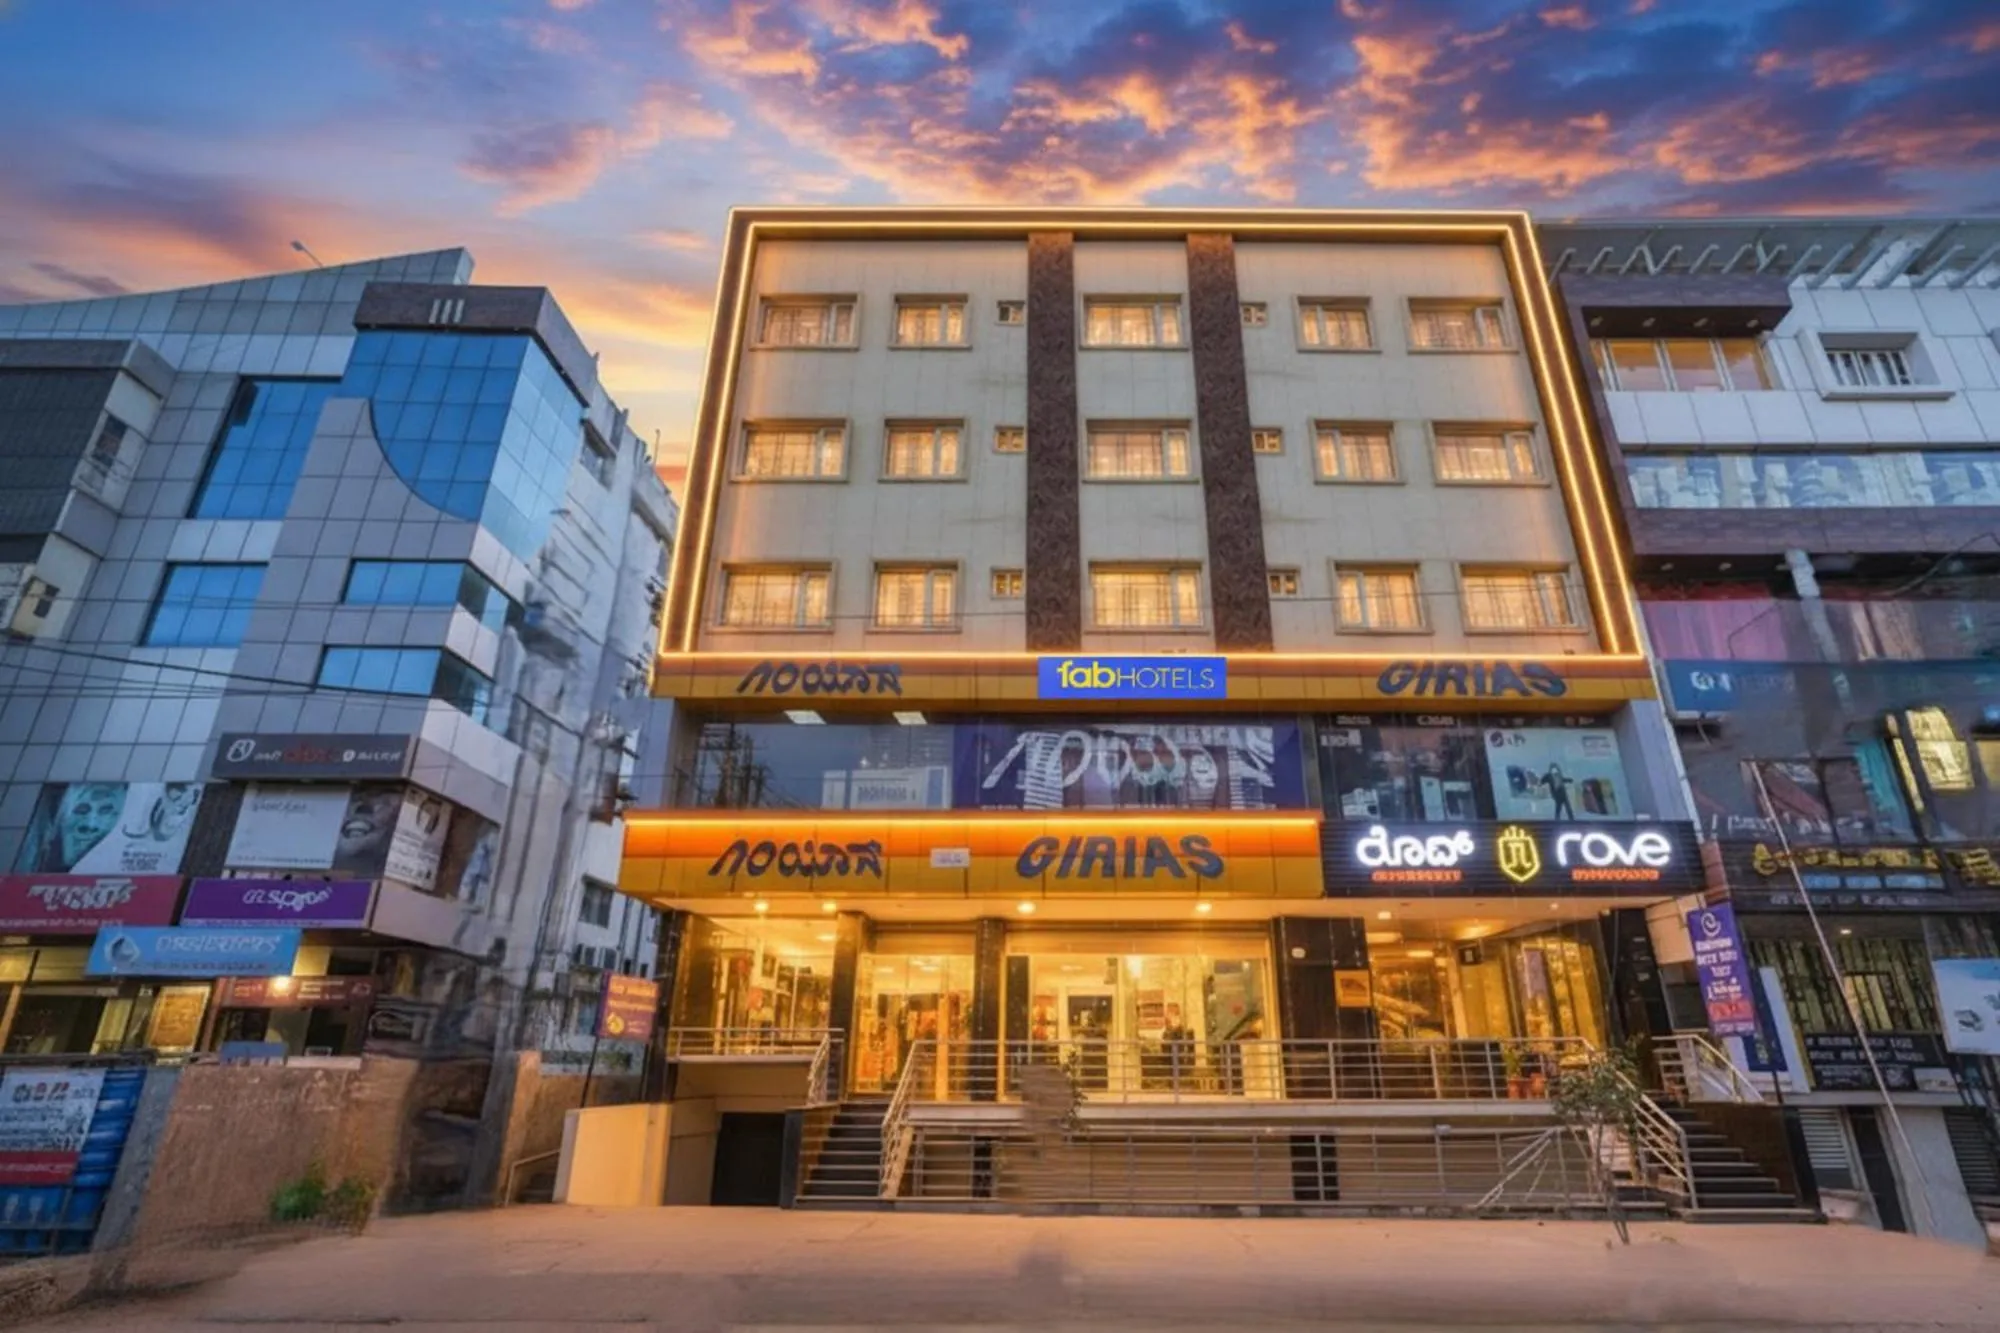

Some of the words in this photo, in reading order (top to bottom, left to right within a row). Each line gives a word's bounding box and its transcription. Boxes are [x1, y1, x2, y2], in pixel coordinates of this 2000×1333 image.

[1056, 660, 1216, 690] fabHOTELS
[1377, 660, 1567, 698] GIRIAS
[1016, 834, 1225, 880] GIRIAS
[1556, 832, 1672, 867] rove
